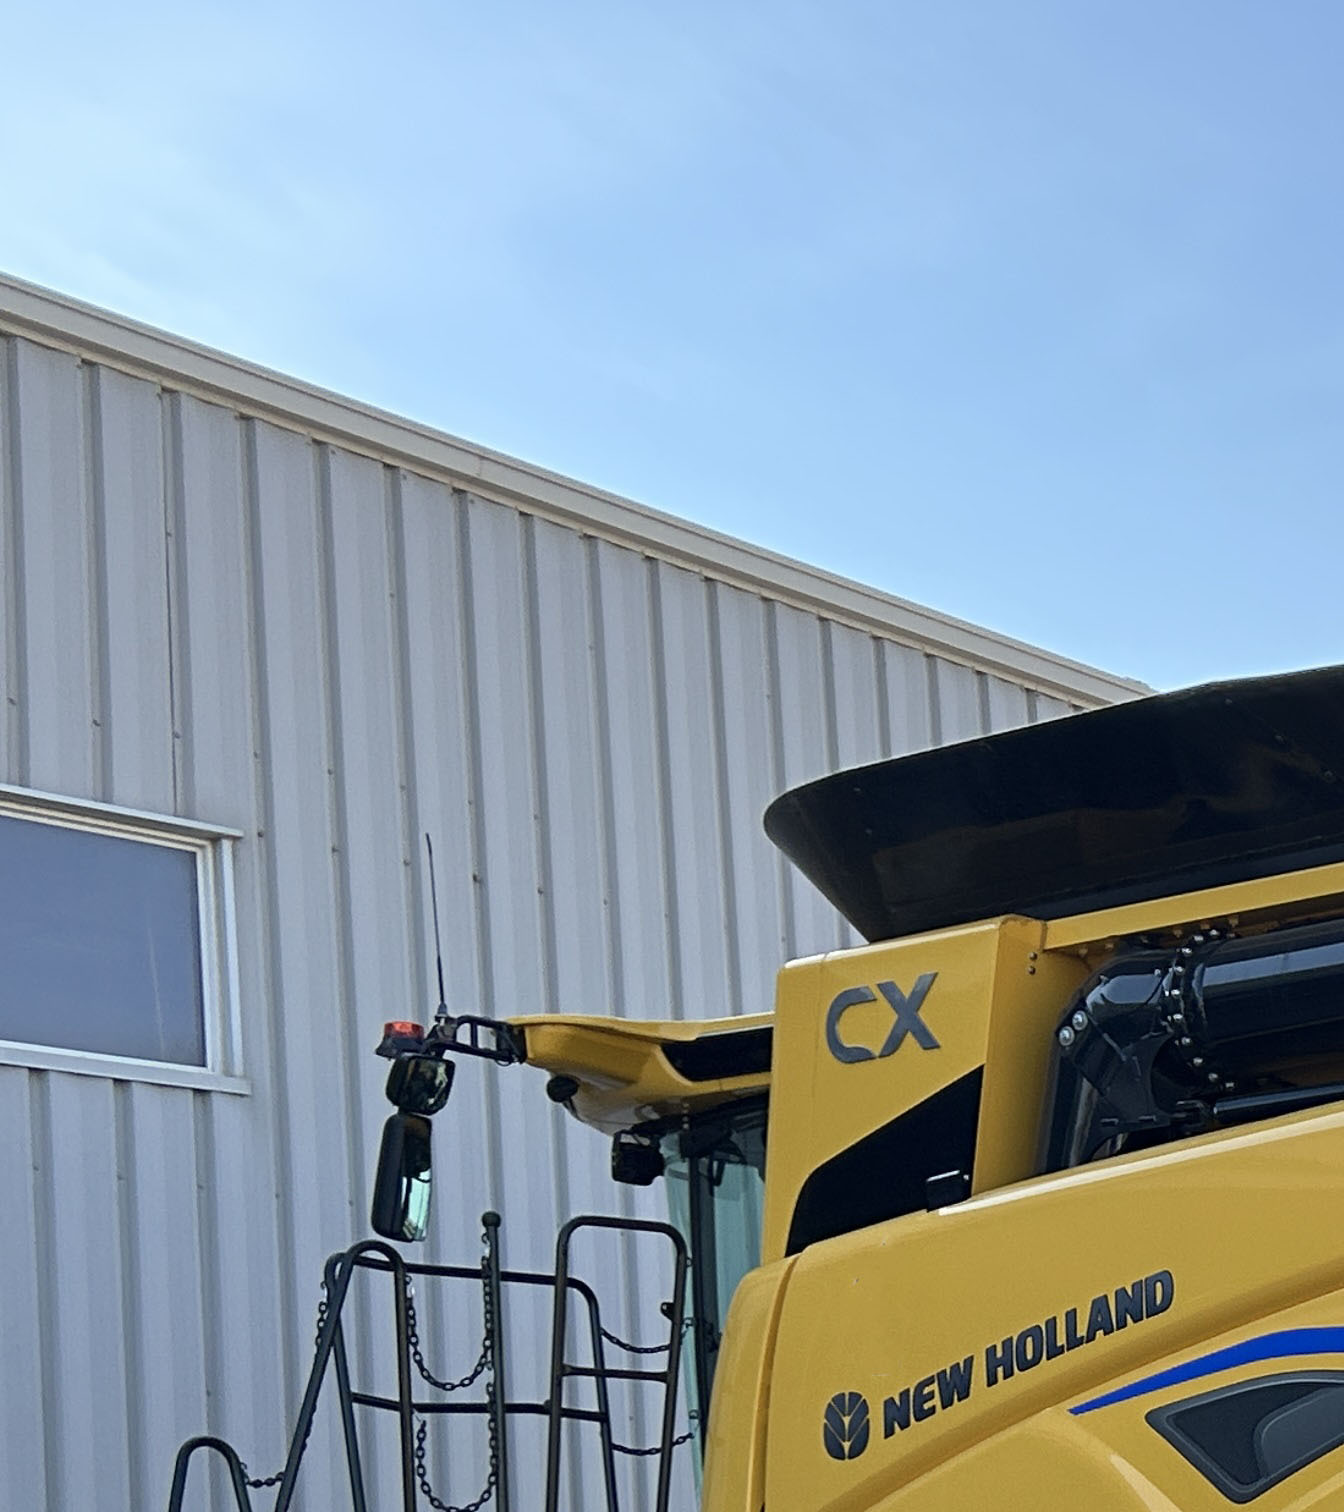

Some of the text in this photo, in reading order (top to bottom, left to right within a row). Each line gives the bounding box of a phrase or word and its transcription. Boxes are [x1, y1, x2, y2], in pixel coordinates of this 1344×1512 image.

[826, 972, 940, 1063] CX
[883, 1269, 1175, 1439] NEW HOLLAND
